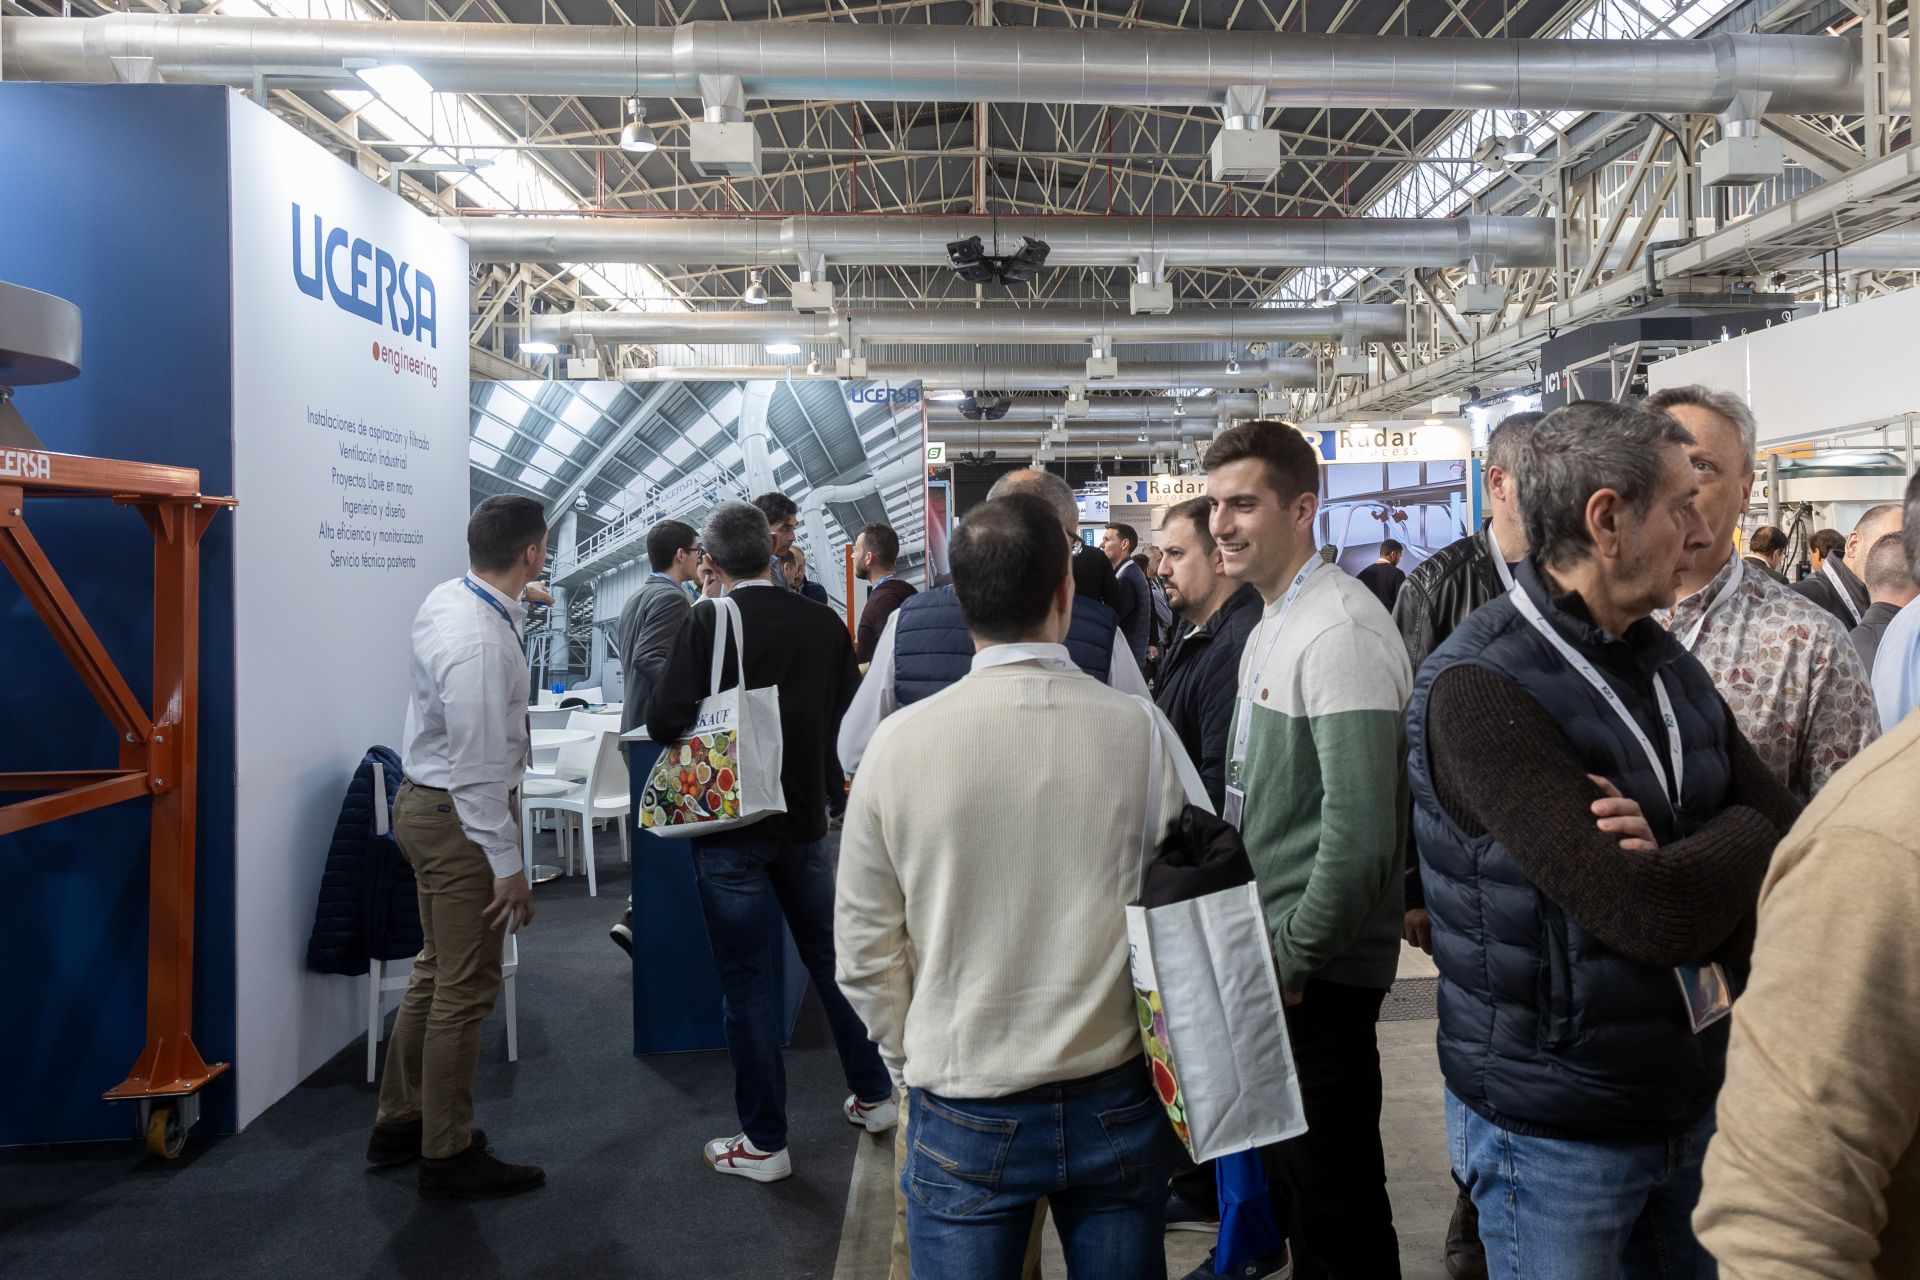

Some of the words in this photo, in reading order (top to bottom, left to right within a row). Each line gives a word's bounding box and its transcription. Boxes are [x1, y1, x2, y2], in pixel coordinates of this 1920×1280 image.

[292, 202, 436, 349] UCERSA
[381, 345, 438, 388] engineering
[851, 388, 920, 404] UCERSA
[307, 405, 356, 433] Instalaciones
[358, 416, 367, 435] de
[369, 425, 403, 445] aspiración
[404, 433, 409, 449] y
[409, 429, 430, 451] filtrado
[1340, 427, 1417, 448] Radar
[339, 440, 378, 464] Ventilación
[331, 466, 366, 491] Proyectos
[368, 472, 385, 491] Llave
[386, 481, 395, 492] en
[396, 483, 414, 495] mano
[1150, 479, 1204, 494] Radar
[379, 505, 384, 521] y
[385, 499, 406, 519] diseño
[318, 519, 335, 540] Alta
[336, 521, 371, 541] eficiencia
[372, 530, 378, 547] y
[379, 528, 424, 545] monitorización
[330, 549, 360, 568] Servicio
[361, 552, 386, 568] técnico
[387, 555, 416, 573] postventa
